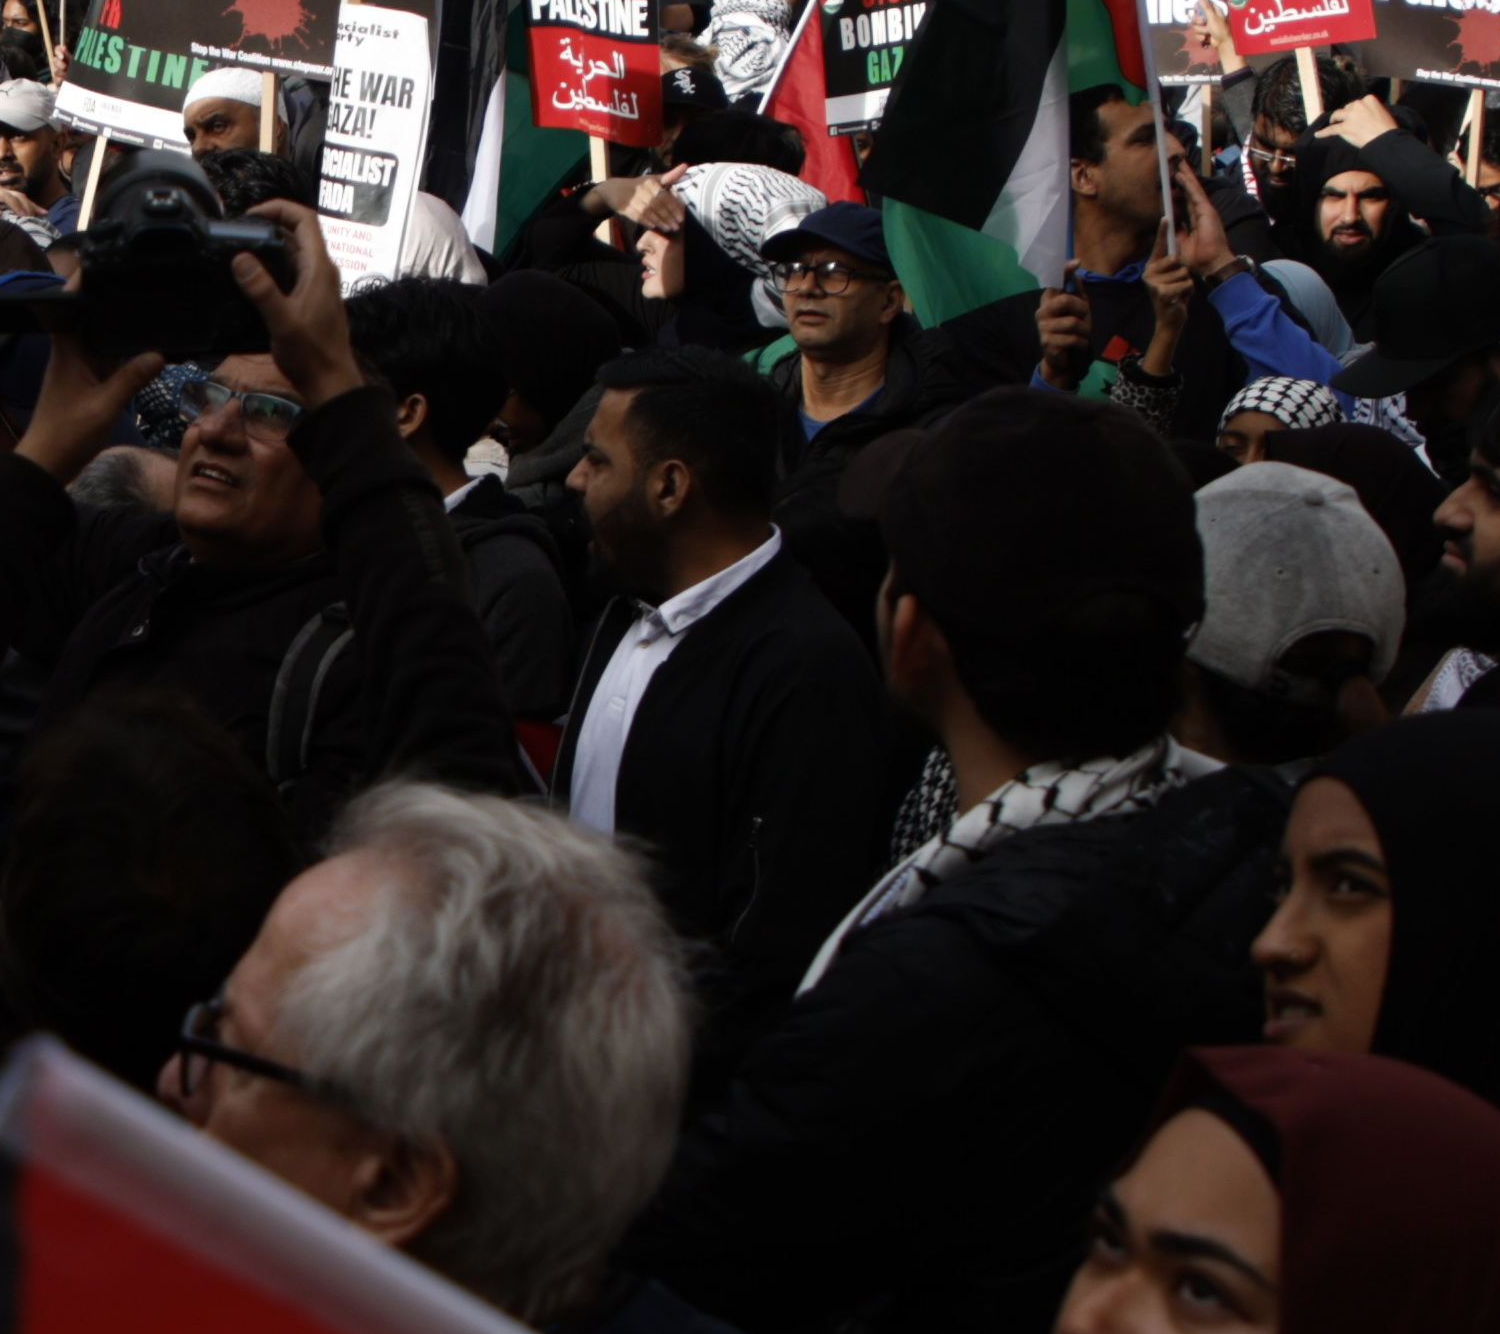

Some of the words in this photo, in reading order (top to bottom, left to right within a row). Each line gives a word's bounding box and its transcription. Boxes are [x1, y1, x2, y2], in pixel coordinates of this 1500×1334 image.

[190, 41, 209, 57] Stop
[208, 45, 222, 58] the
[221, 48, 238, 61] War
[237, 50, 272, 66] Coalition
[559, 36, 626, 81] الحرية
[359, 71, 415, 110] WAR
[552, 78, 640, 120] لفلسطين
[352, 228, 373, 242] AND
